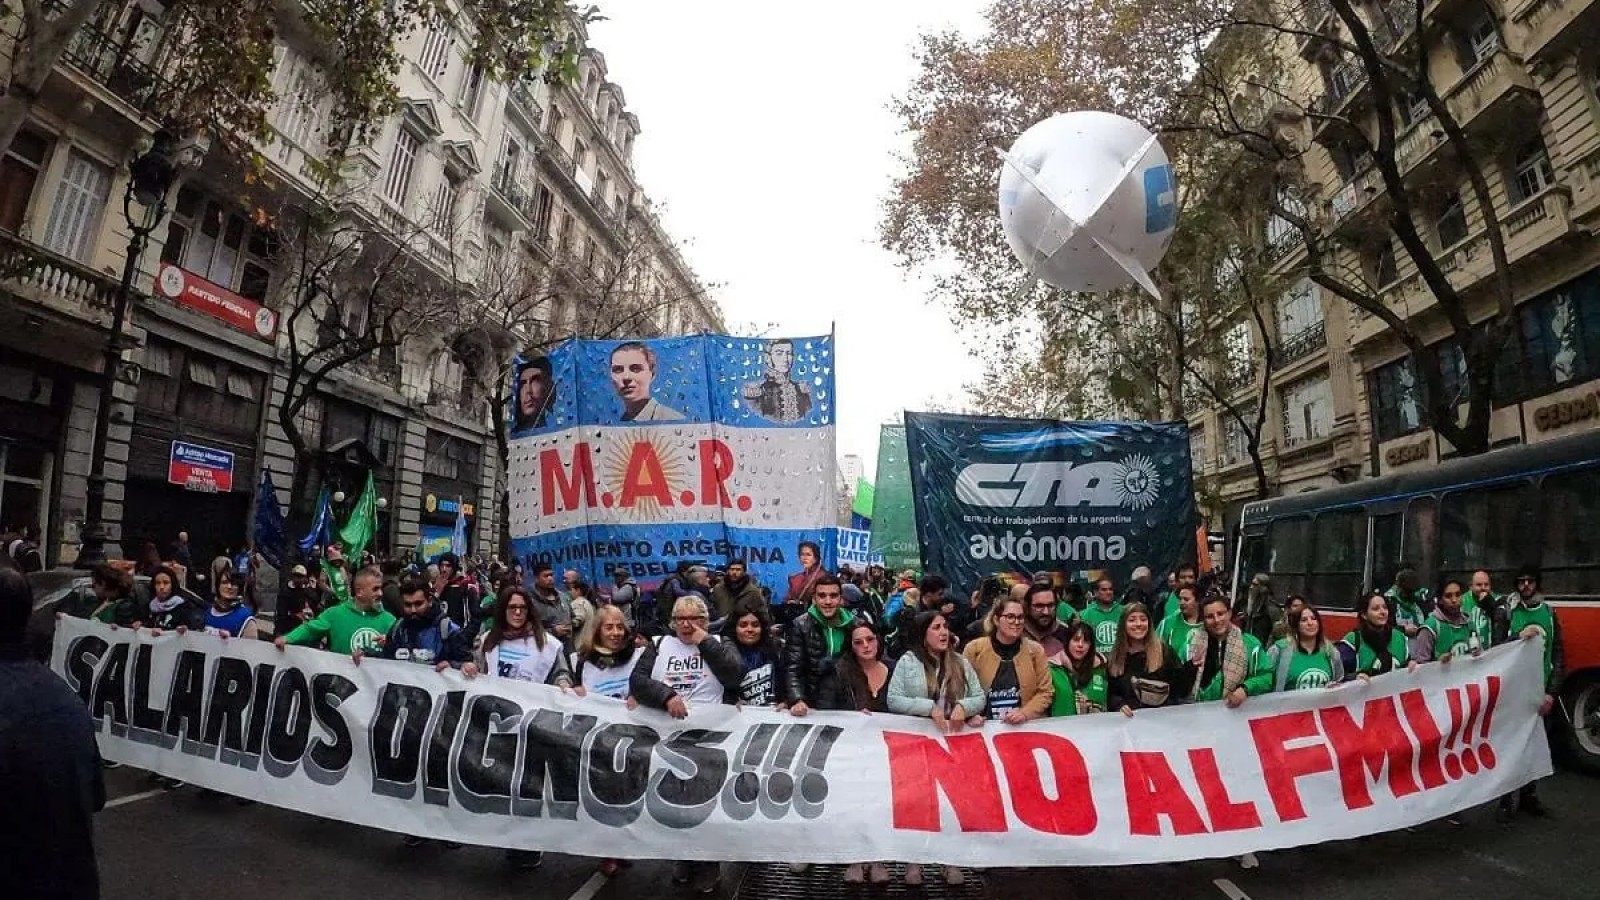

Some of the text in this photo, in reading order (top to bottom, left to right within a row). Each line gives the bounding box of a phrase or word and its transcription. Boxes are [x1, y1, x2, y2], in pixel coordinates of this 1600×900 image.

[539, 438, 752, 516] M.A.R.
[955, 461, 1123, 508] CTA
[992, 516, 1004, 525] de
[1067, 515, 1079, 524] de
[1080, 515, 1089, 524] la
[1090, 516, 1132, 527] argentina
[526, 540, 653, 569] MOVIMIENTO
[970, 530, 1126, 562] autónoma
[64, 635, 358, 785] SALARIOS
[881, 731, 1097, 836] NO
[1119, 748, 1262, 836] AL
[1248, 675, 1501, 822] FMI!!!
